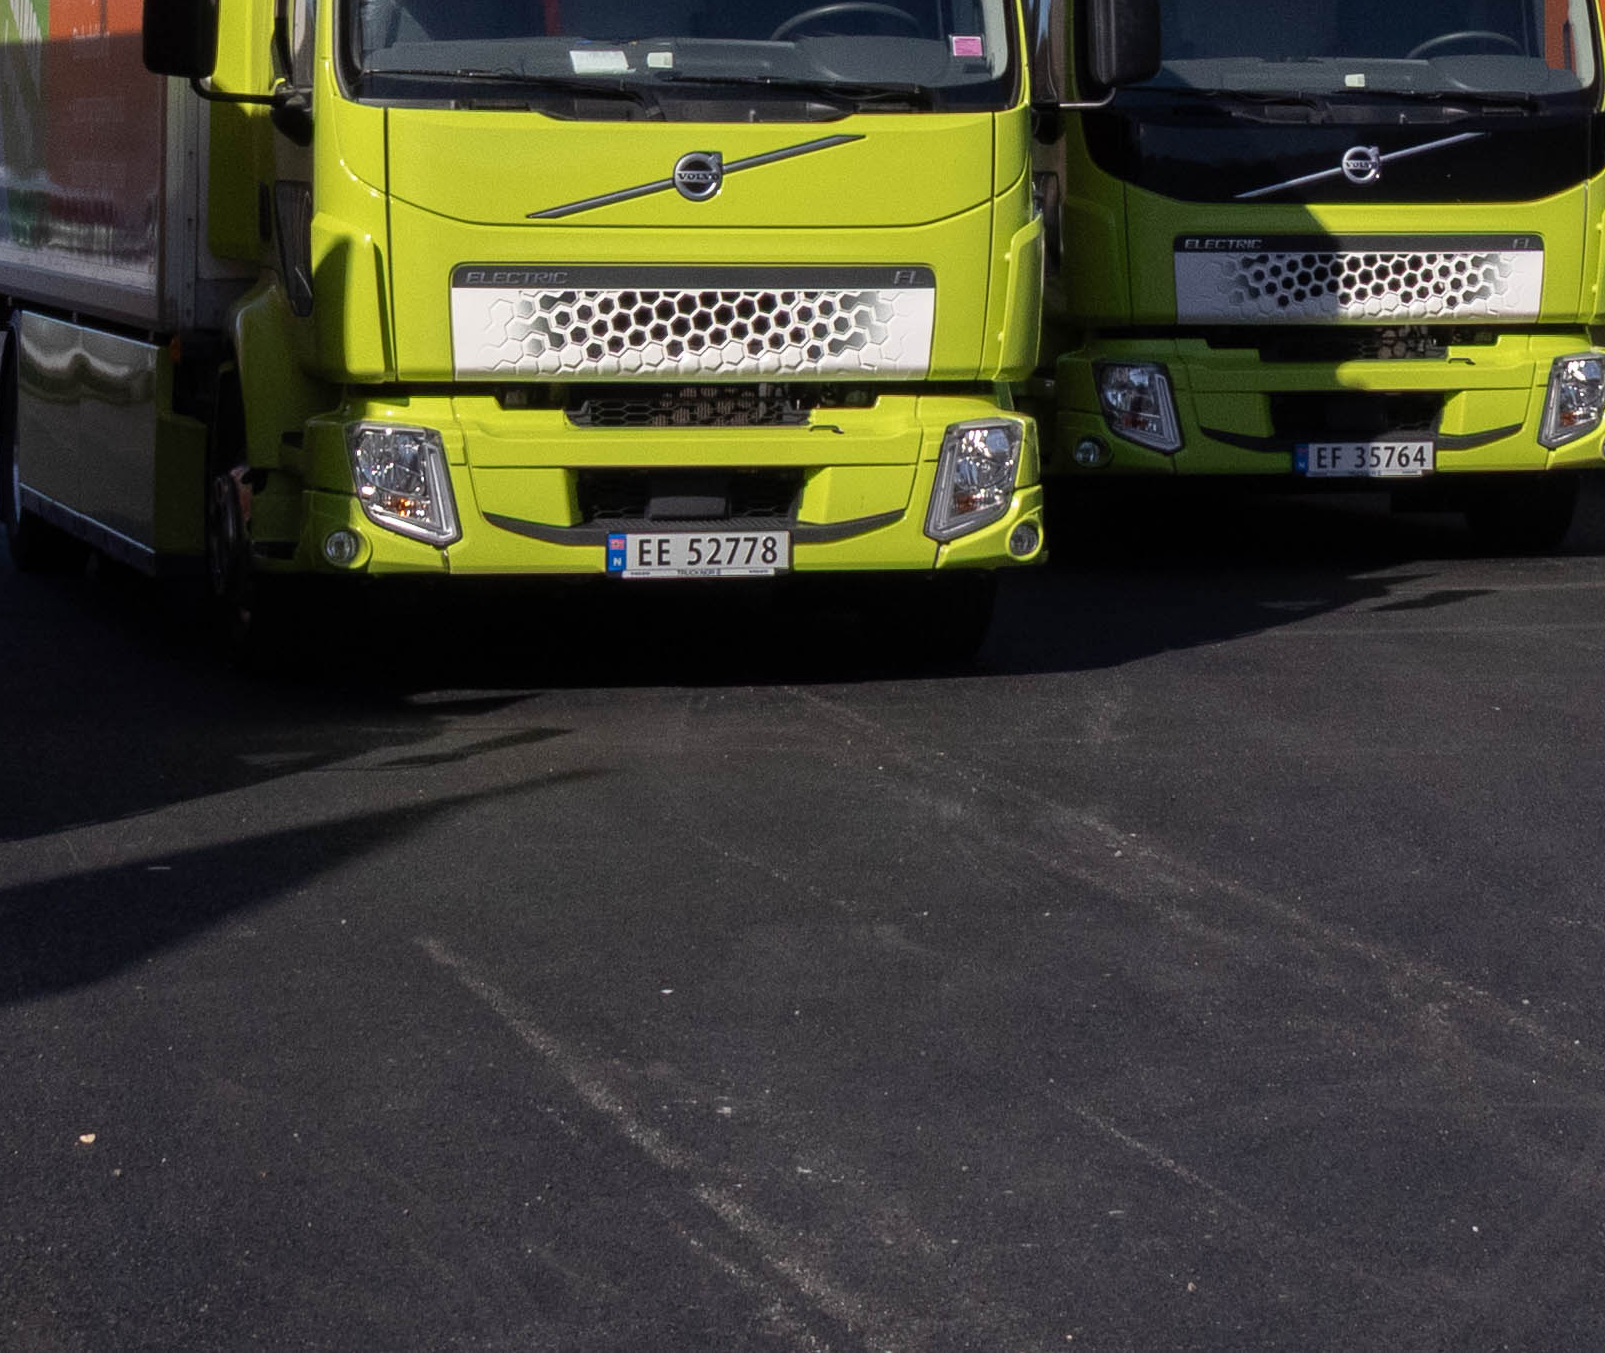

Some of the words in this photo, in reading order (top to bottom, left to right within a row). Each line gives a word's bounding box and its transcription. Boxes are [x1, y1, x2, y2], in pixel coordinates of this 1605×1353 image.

[1185, 239, 1262, 249] ELECTRIC
[466, 272, 568, 284] ELECTRIC
[1317, 447, 1341, 468] EF
[1355, 446, 1426, 467] 35764
[638, 539, 671, 566] EE
[687, 536, 778, 565] 52778
[613, 557, 622, 566] N
